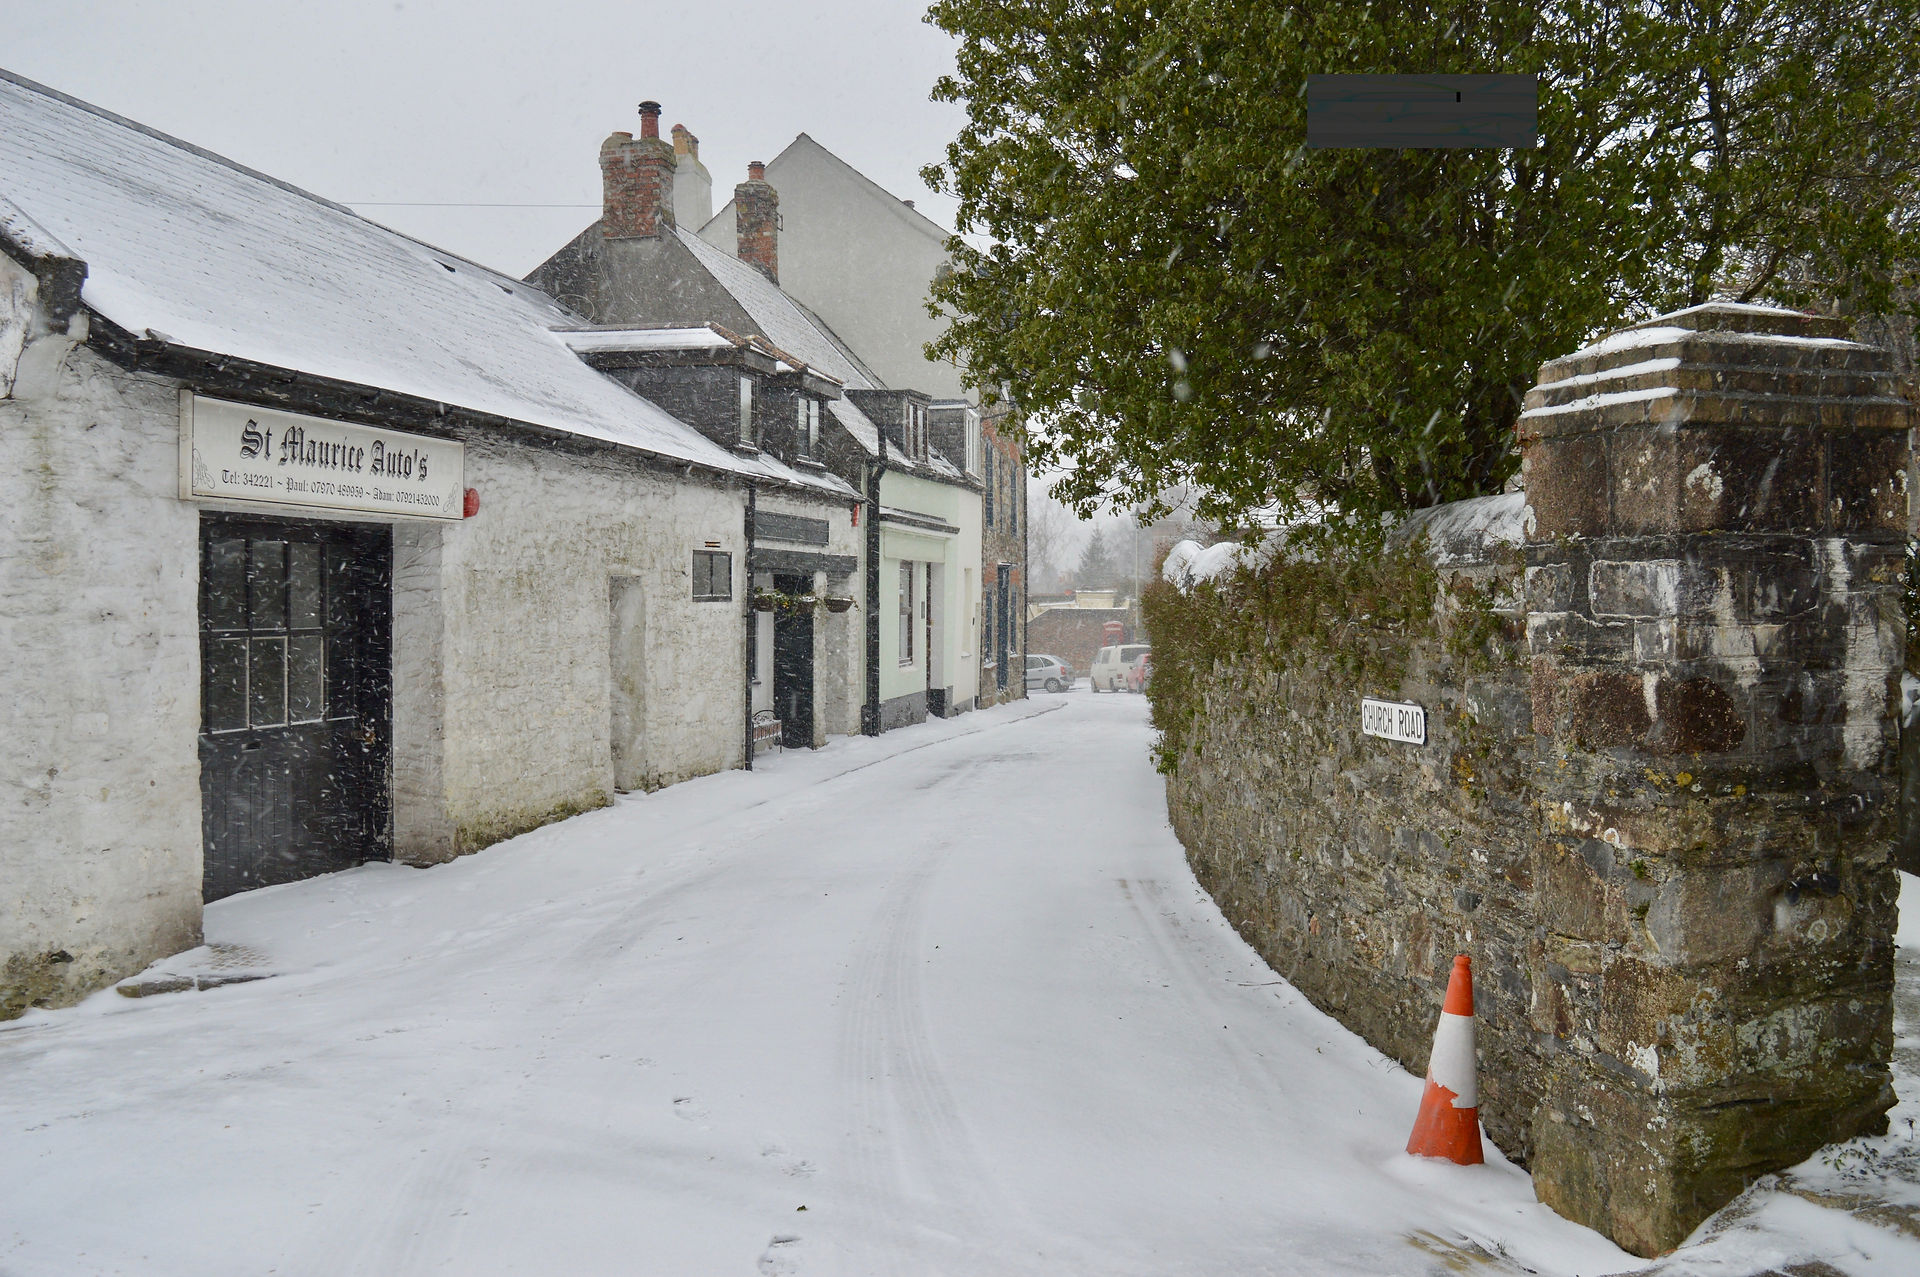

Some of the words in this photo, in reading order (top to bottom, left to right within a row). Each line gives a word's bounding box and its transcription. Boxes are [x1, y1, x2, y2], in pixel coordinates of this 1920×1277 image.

[240, 419, 272, 459] St
[278, 425, 364, 473] Maurice
[370, 439, 429, 481] Auto's
[221, 469, 239, 485] Tel:
[243, 472, 272, 488] 342221
[286, 477, 309, 493] Paul:
[311, 482, 335, 496] 07970
[1363, 704, 1393, 735] CHURCH
[1398, 709, 1422, 739] ROAD
